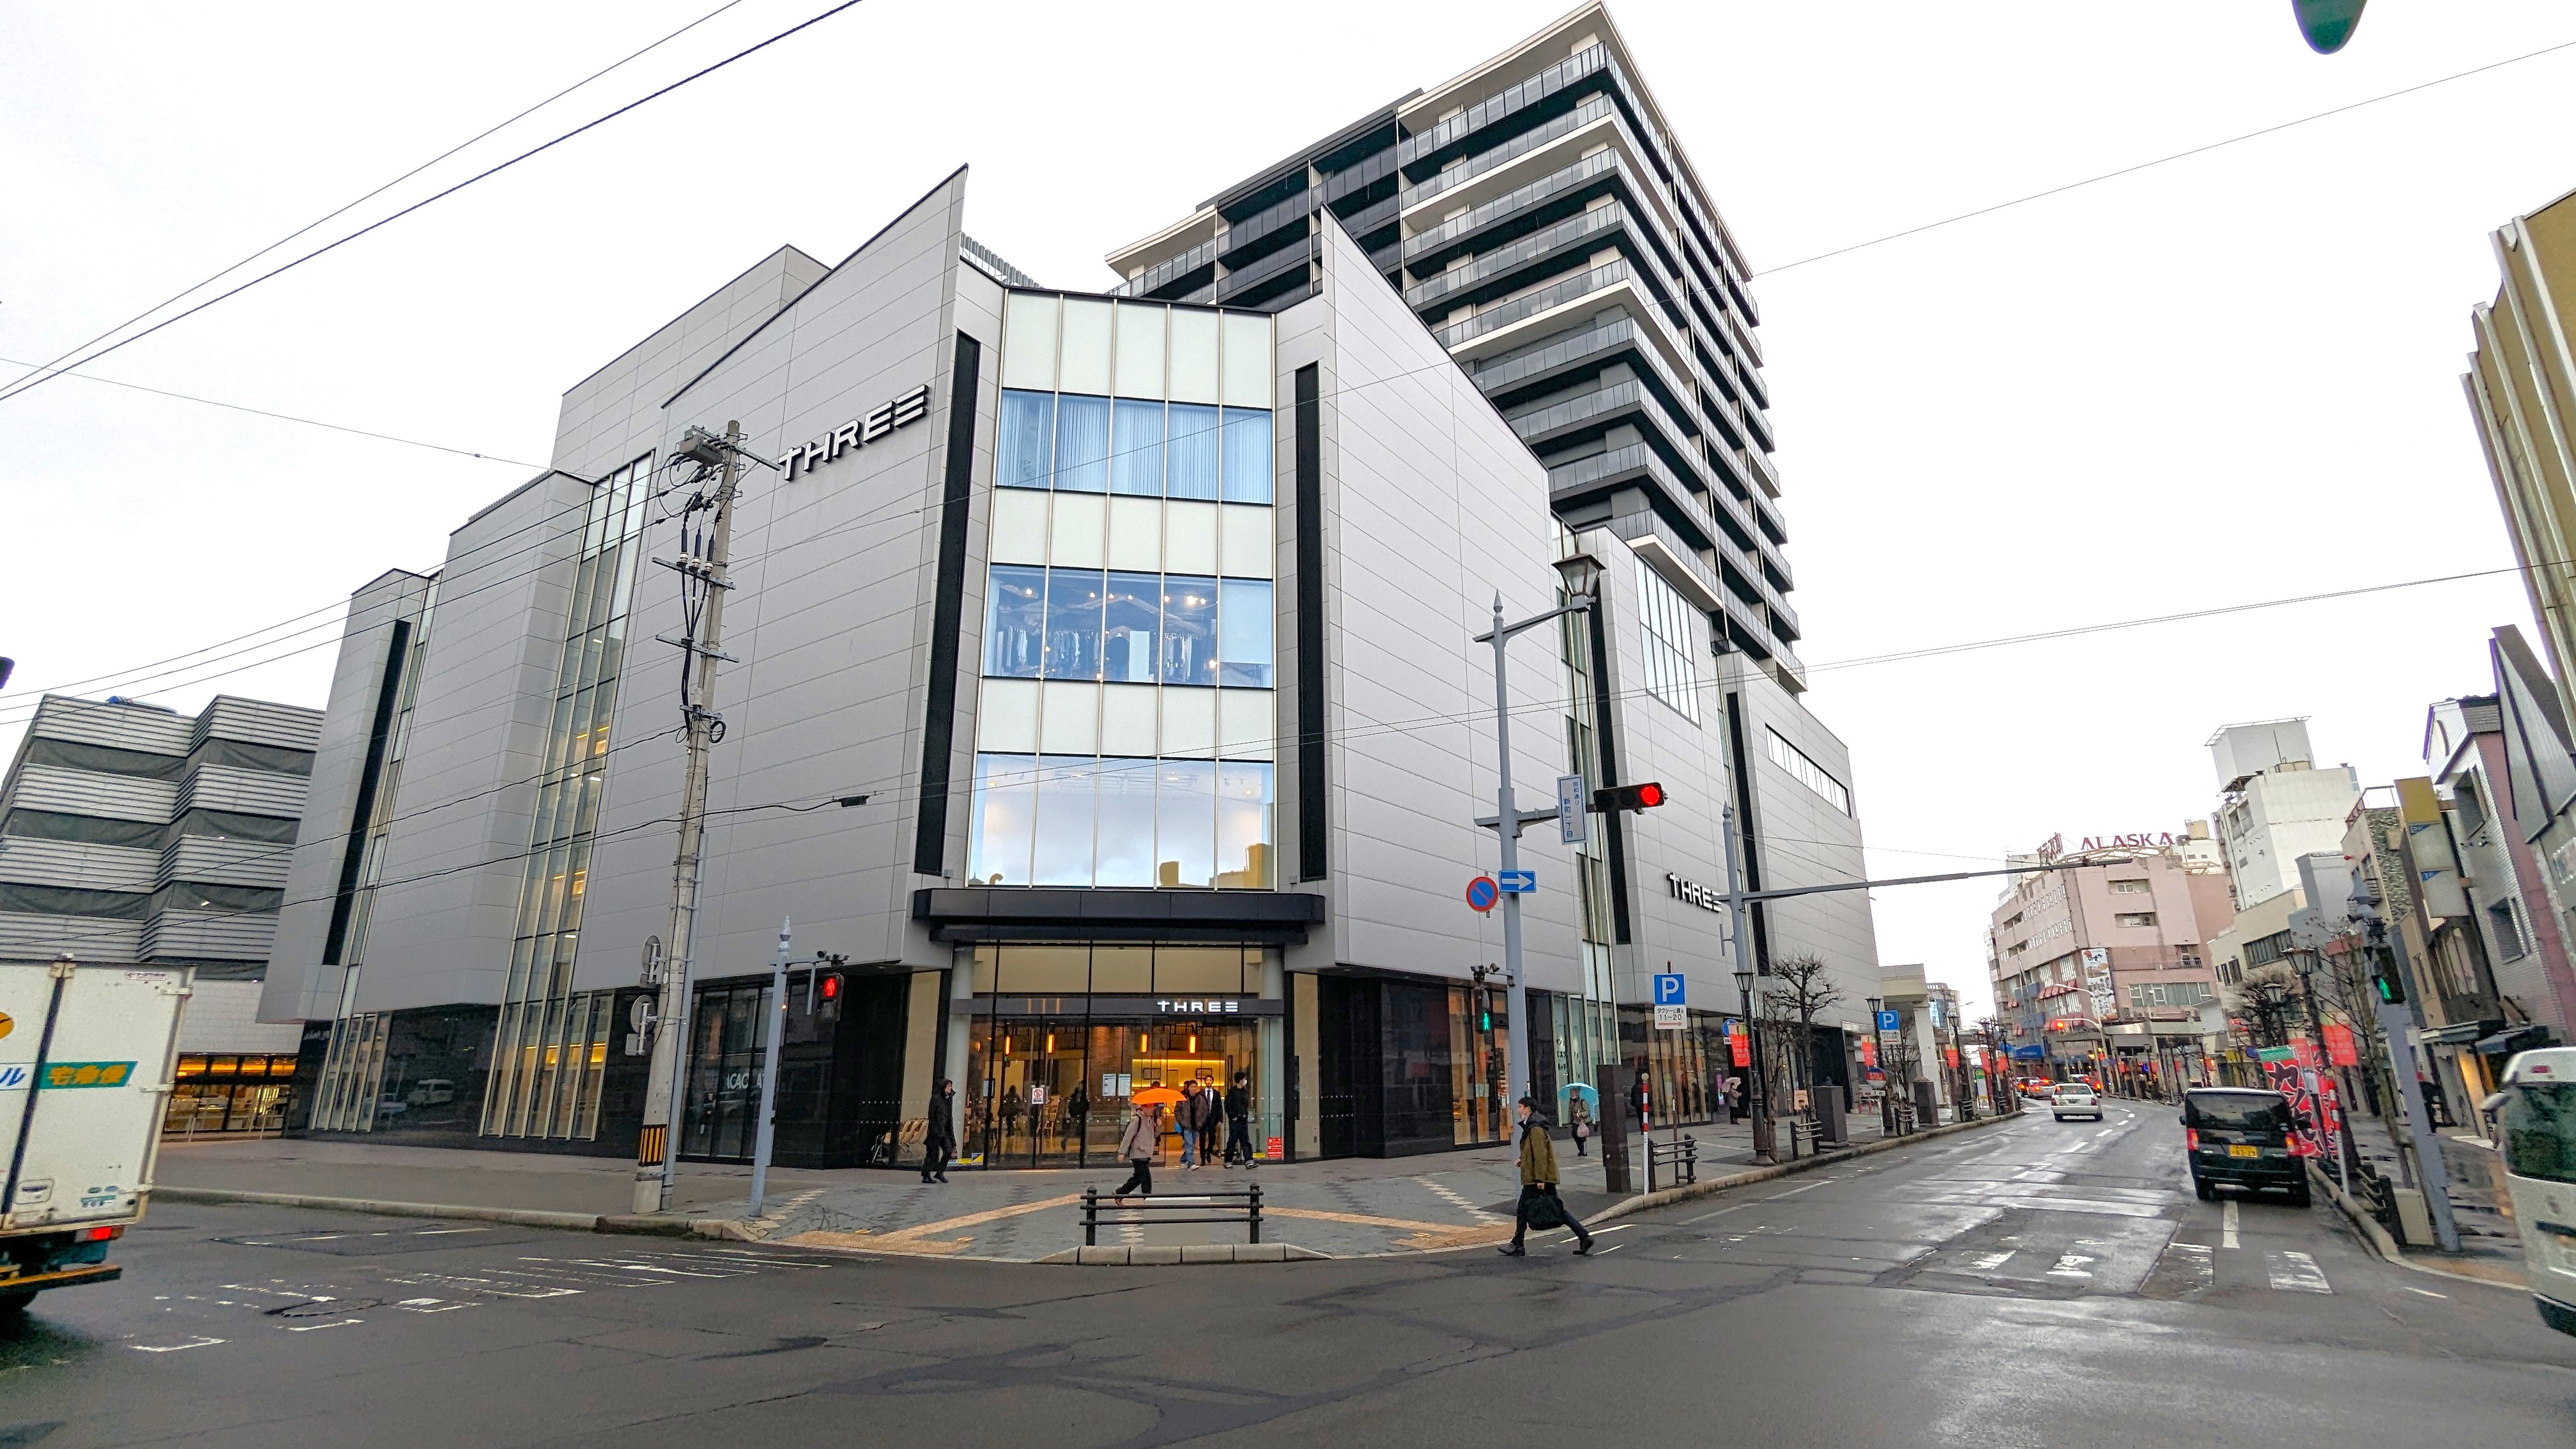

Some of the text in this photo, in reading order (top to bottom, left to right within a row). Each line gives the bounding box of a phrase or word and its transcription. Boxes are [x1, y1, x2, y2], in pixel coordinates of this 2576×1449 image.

[778, 384, 928, 481] THREE
[1564, 797, 1573, 838] 新町一丁目
[2080, 832, 2175, 851] ALASKA
[1666, 872, 1722, 913] THREE
[1662, 977, 1680, 1002] P
[1157, 1000, 1238, 1013] THREE
[1883, 1013, 1894, 1028] P
